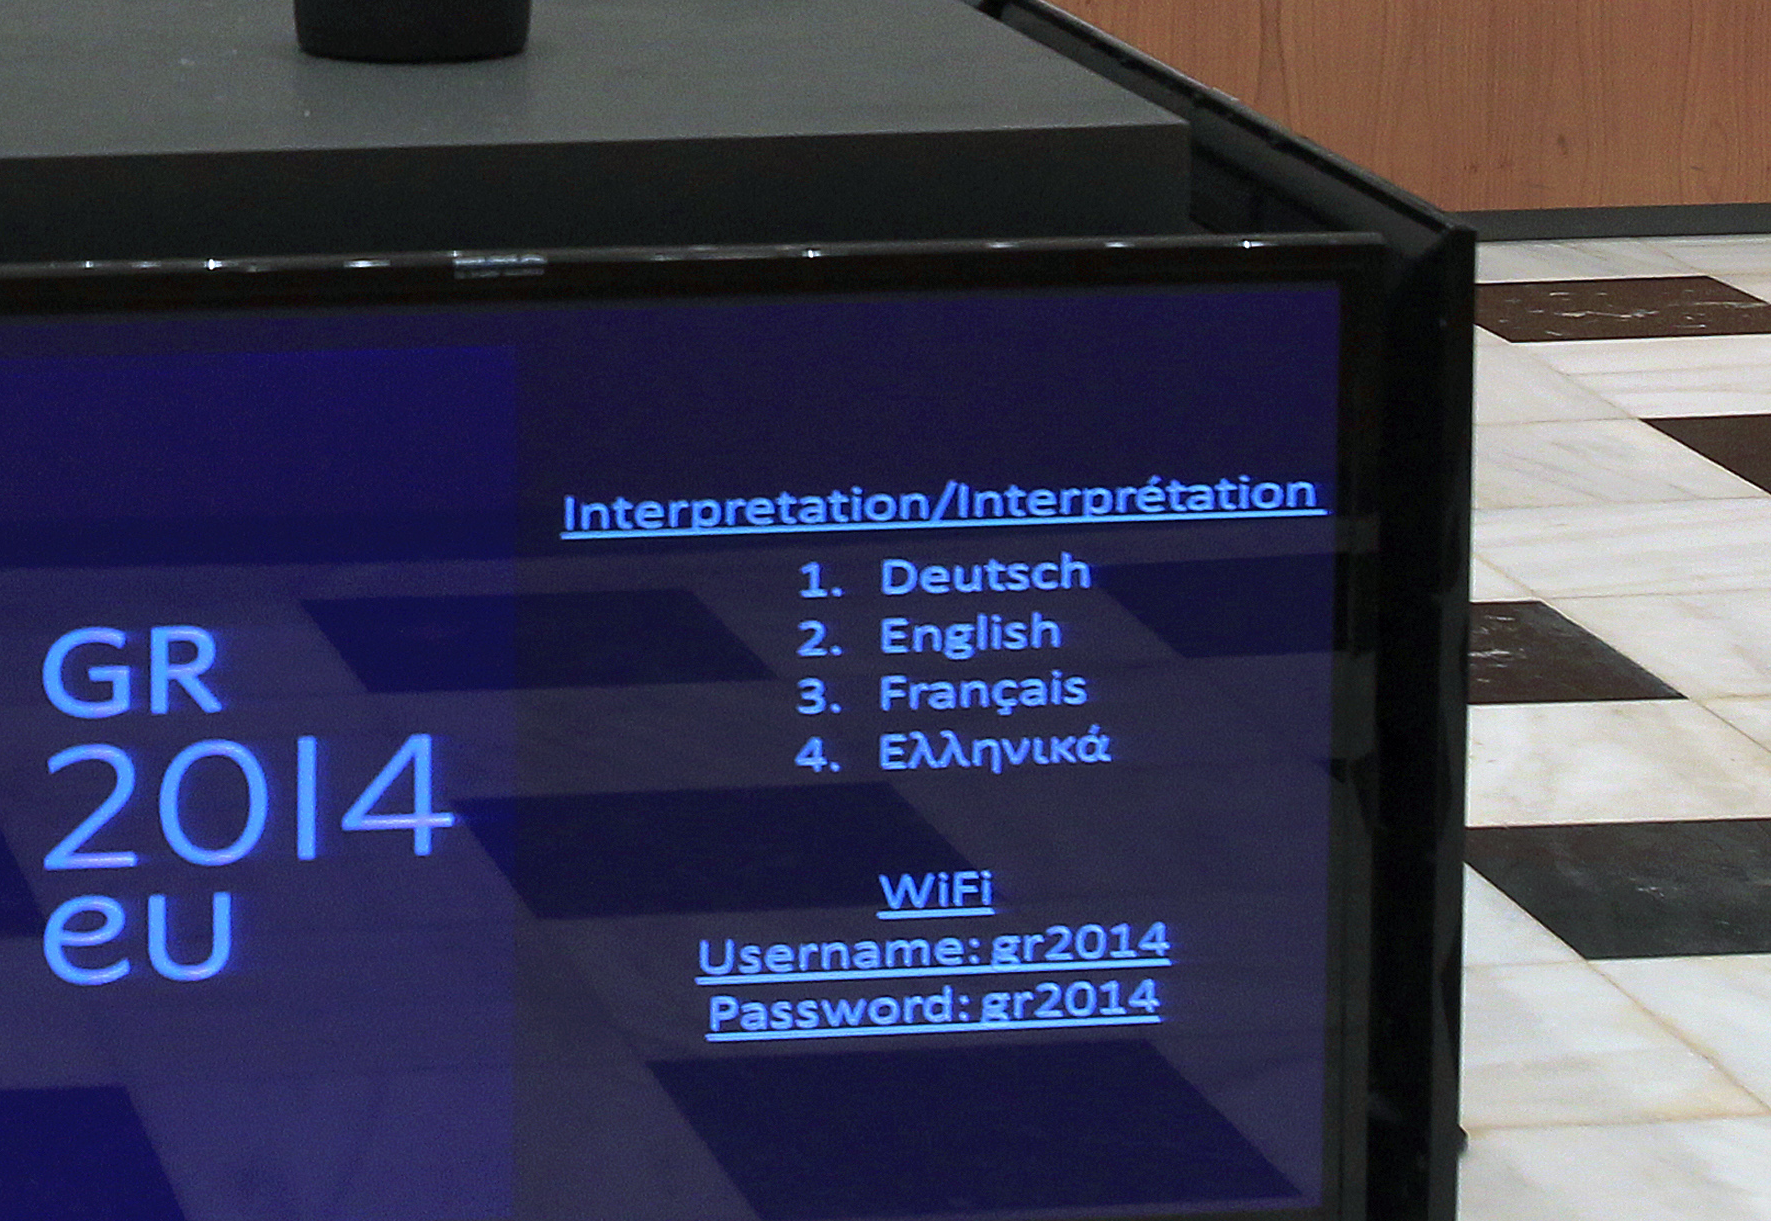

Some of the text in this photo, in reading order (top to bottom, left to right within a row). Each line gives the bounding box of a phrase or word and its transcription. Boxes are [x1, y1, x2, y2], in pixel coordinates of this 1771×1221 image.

[562, 475, 1321, 536] Interpretation/Interprétation
[798, 551, 1092, 597] 1. Deutsch
[797, 612, 1062, 661] 2. English
[42, 625, 222, 719] GR
[796, 670, 1088, 717] 3. Français
[795, 724, 1112, 775] 4. Ελληνικά
[44, 734, 455, 871] 2014
[878, 870, 995, 916] WiFi
[697, 921, 1172, 982] Username: gr2014
[708, 979, 1161, 1038] Password: gr2014
